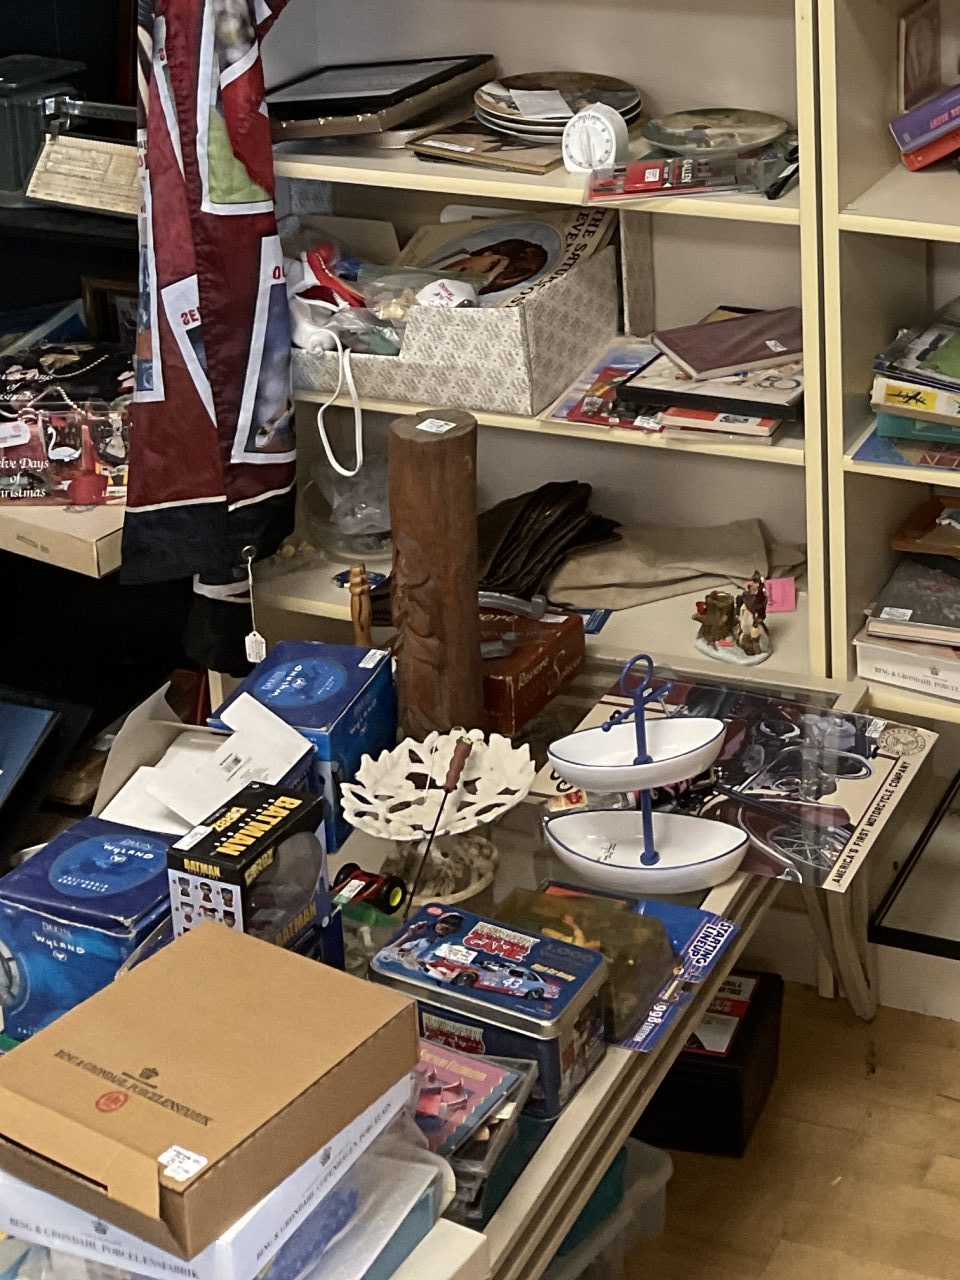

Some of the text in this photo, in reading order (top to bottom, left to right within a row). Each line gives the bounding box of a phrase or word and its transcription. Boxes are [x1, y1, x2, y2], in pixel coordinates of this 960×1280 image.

[587, 208, 608, 239] THE
[19, 457, 49, 474] Days
[215, 795, 303, 856] BATMAN
[832, 848, 858, 884] AMERICA'S
[856, 828, 870, 848] FIRST
[865, 788, 895, 827] MOTORCYCLE
[889, 761, 911, 788] COMPANY
[183, 858, 221, 879] BATMAN
[688, 923, 714, 959] LINEUP
[695, 921, 734, 967] STARTING
[503, 977, 523, 989] 43
